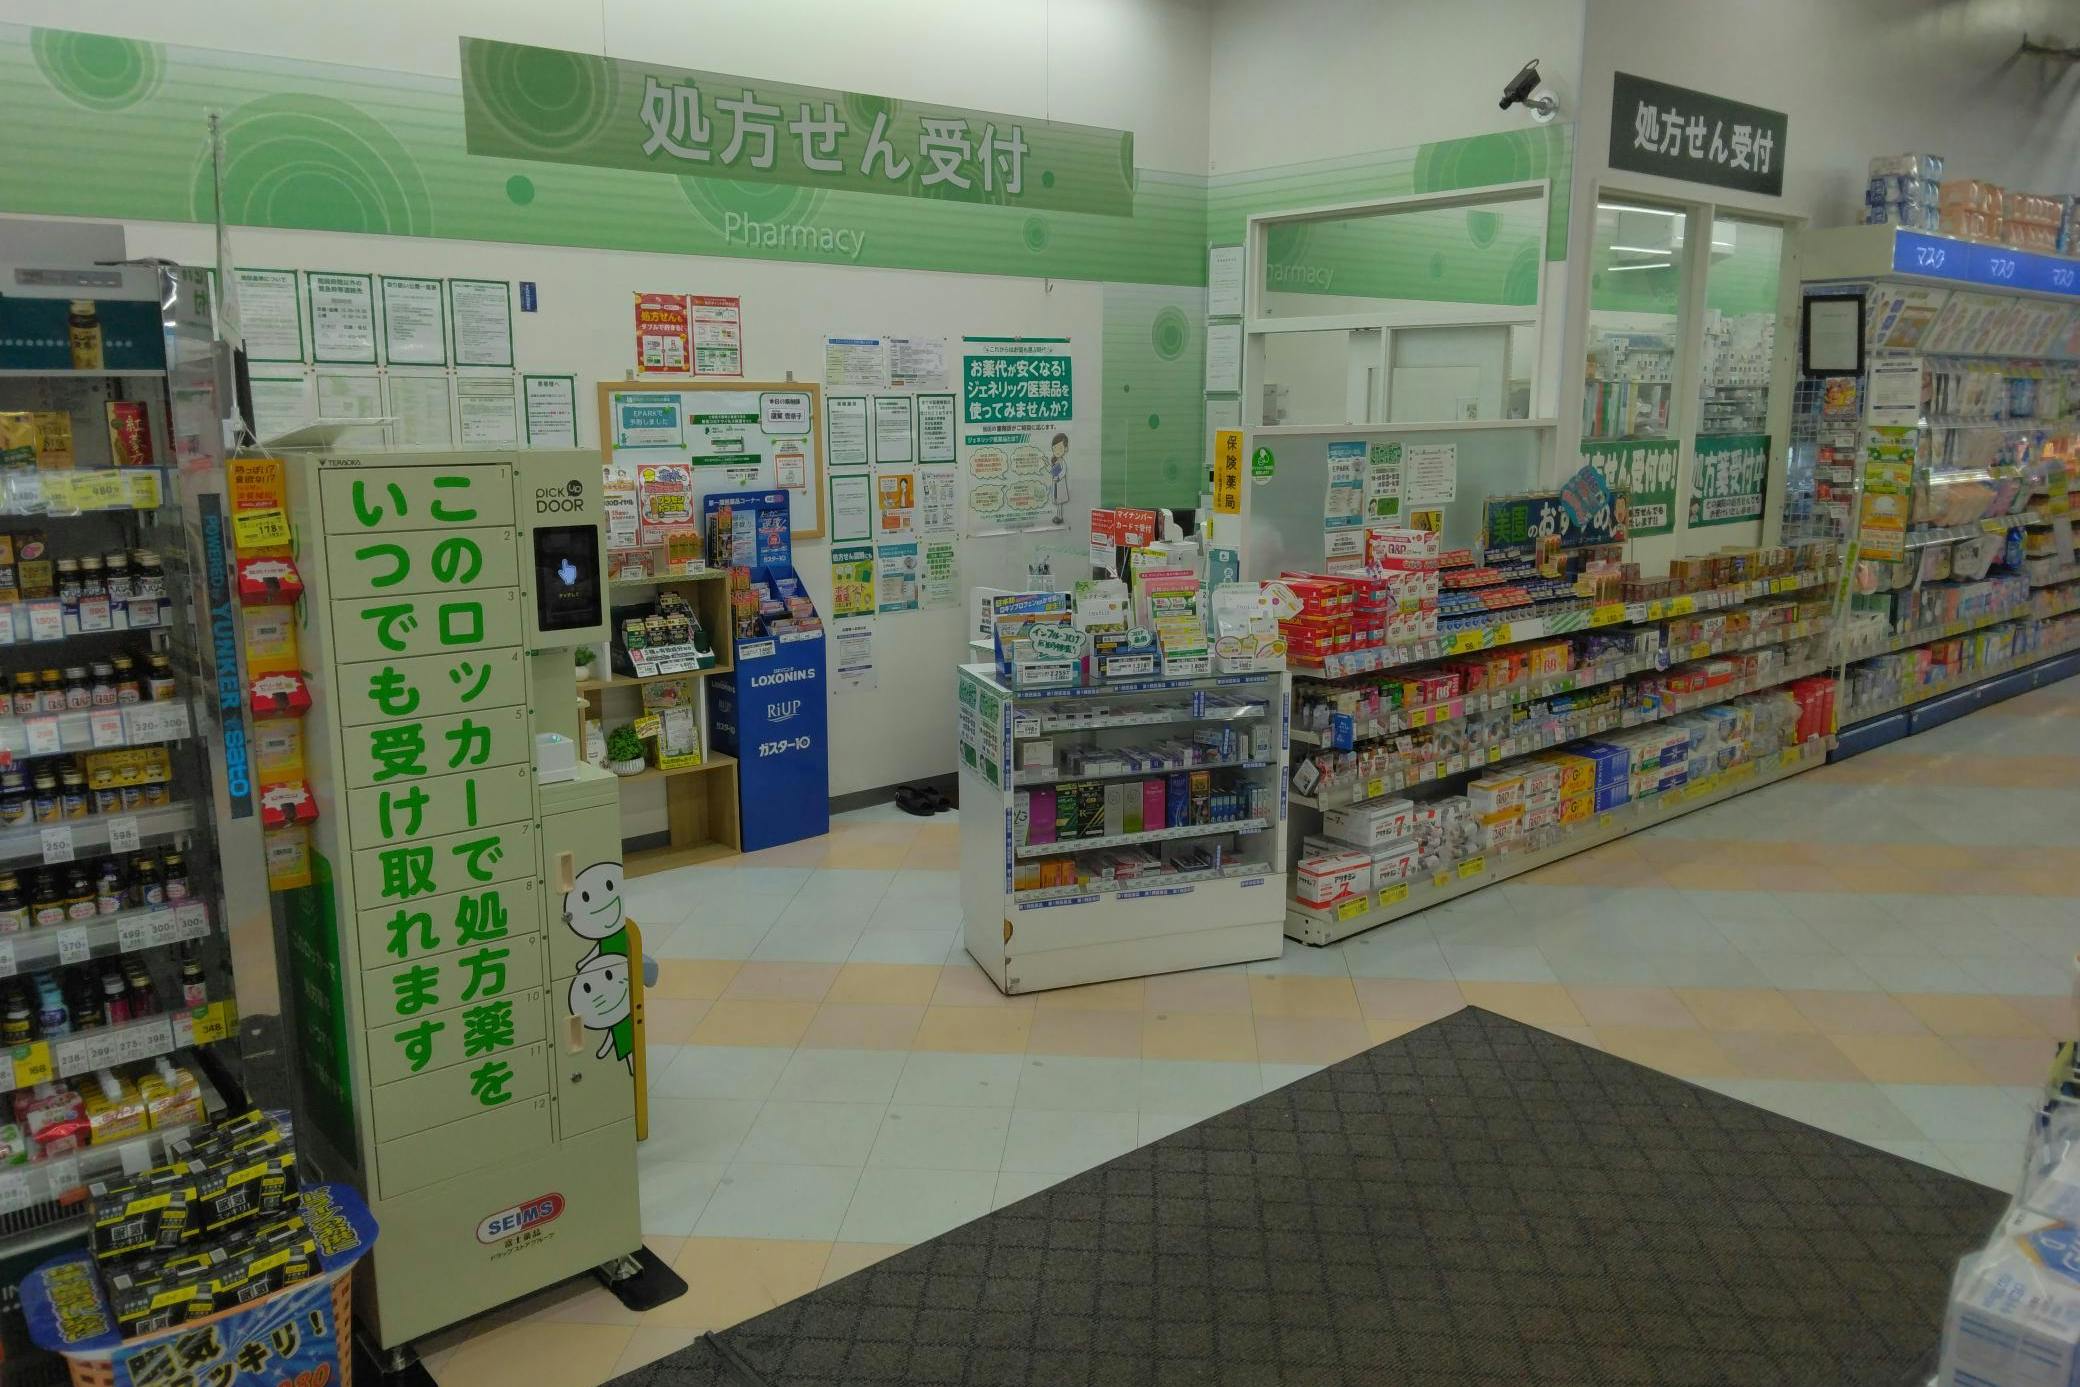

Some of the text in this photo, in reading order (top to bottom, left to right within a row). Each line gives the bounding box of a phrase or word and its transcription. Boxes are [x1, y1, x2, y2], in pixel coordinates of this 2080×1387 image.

[640, 75, 1029, 195] 処方せん受付
[1634, 100, 1774, 174] 処方せん受付
[725, 211, 866, 260] Pharmacy
[1917, 246, 1945, 269] マスク
[970, 360, 1066, 379] お薬代が安くなる!
[968, 380, 1070, 399] ジェネリック医薬品を
[969, 400, 1069, 420] 使ってみませんか?
[501, 468, 505, 478] 1
[1225, 435, 1238, 509] 保険薬局
[536, 499, 584, 514] DOOR
[1117, 510, 1153, 520] マイナンバー
[1116, 521, 1152, 534] カードで受付
[504, 531, 510, 541] 2
[207, 514, 224, 587] POWERED
[508, 591, 514, 601] 3
[211, 602, 241, 707] YUNKER
[512, 653, 518, 662] 4
[515, 710, 522, 719] 5
[767, 700, 801, 718] RiUP
[759, 736, 811, 757] ガスター10
[352, 480, 446, 1072] いつでも受け取れます
[519, 767, 525, 777] 6
[431, 476, 515, 1106] このロッカーで処方薬を
[522, 824, 528, 834] 7
[526, 880, 532, 890] 8
[528, 936, 535, 945] 9
[527, 991, 539, 1002] 10
[530, 1046, 542, 1056] 11
[533, 1098, 545, 1111] 12
[487, 1200, 555, 1237] SEIMS
